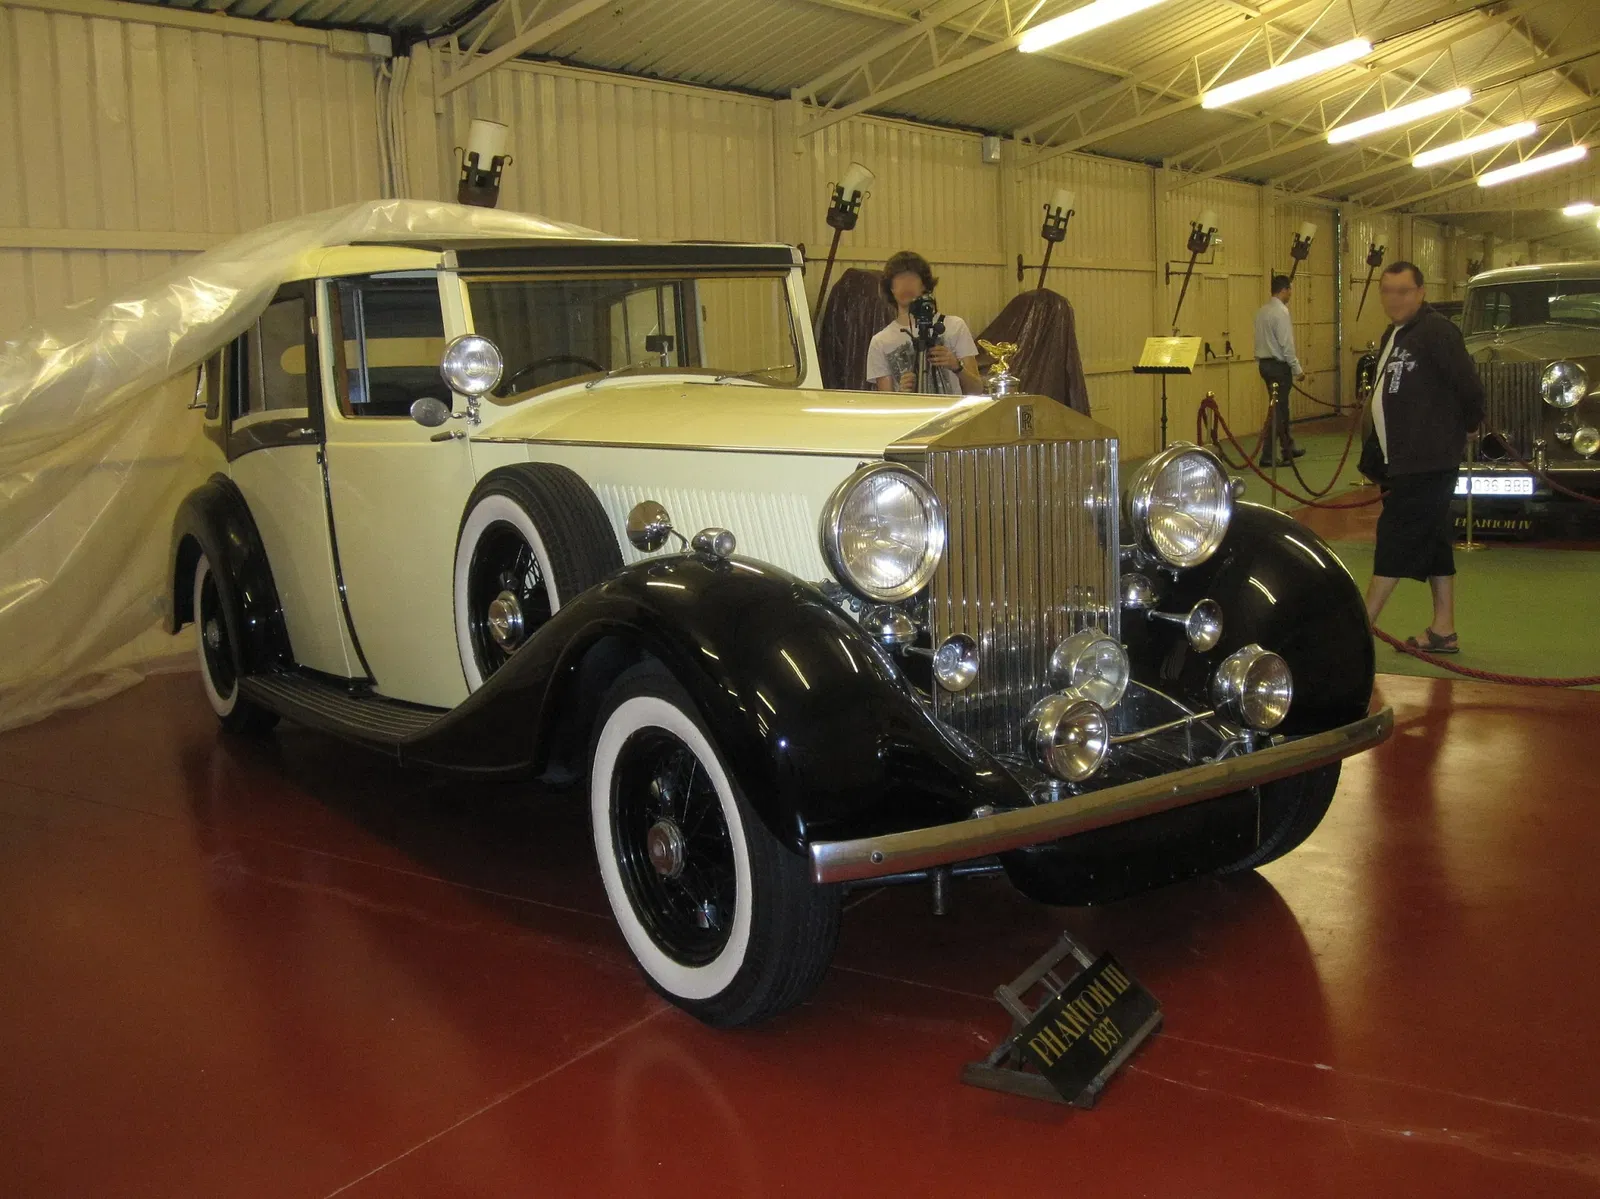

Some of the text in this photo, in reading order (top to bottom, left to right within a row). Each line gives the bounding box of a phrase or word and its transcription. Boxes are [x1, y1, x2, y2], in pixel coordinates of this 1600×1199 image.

[1519, 519, 1532, 529] IV
[1028, 964, 1131, 1067] PHANTOM III
[1088, 1016, 1123, 1056] 1937
